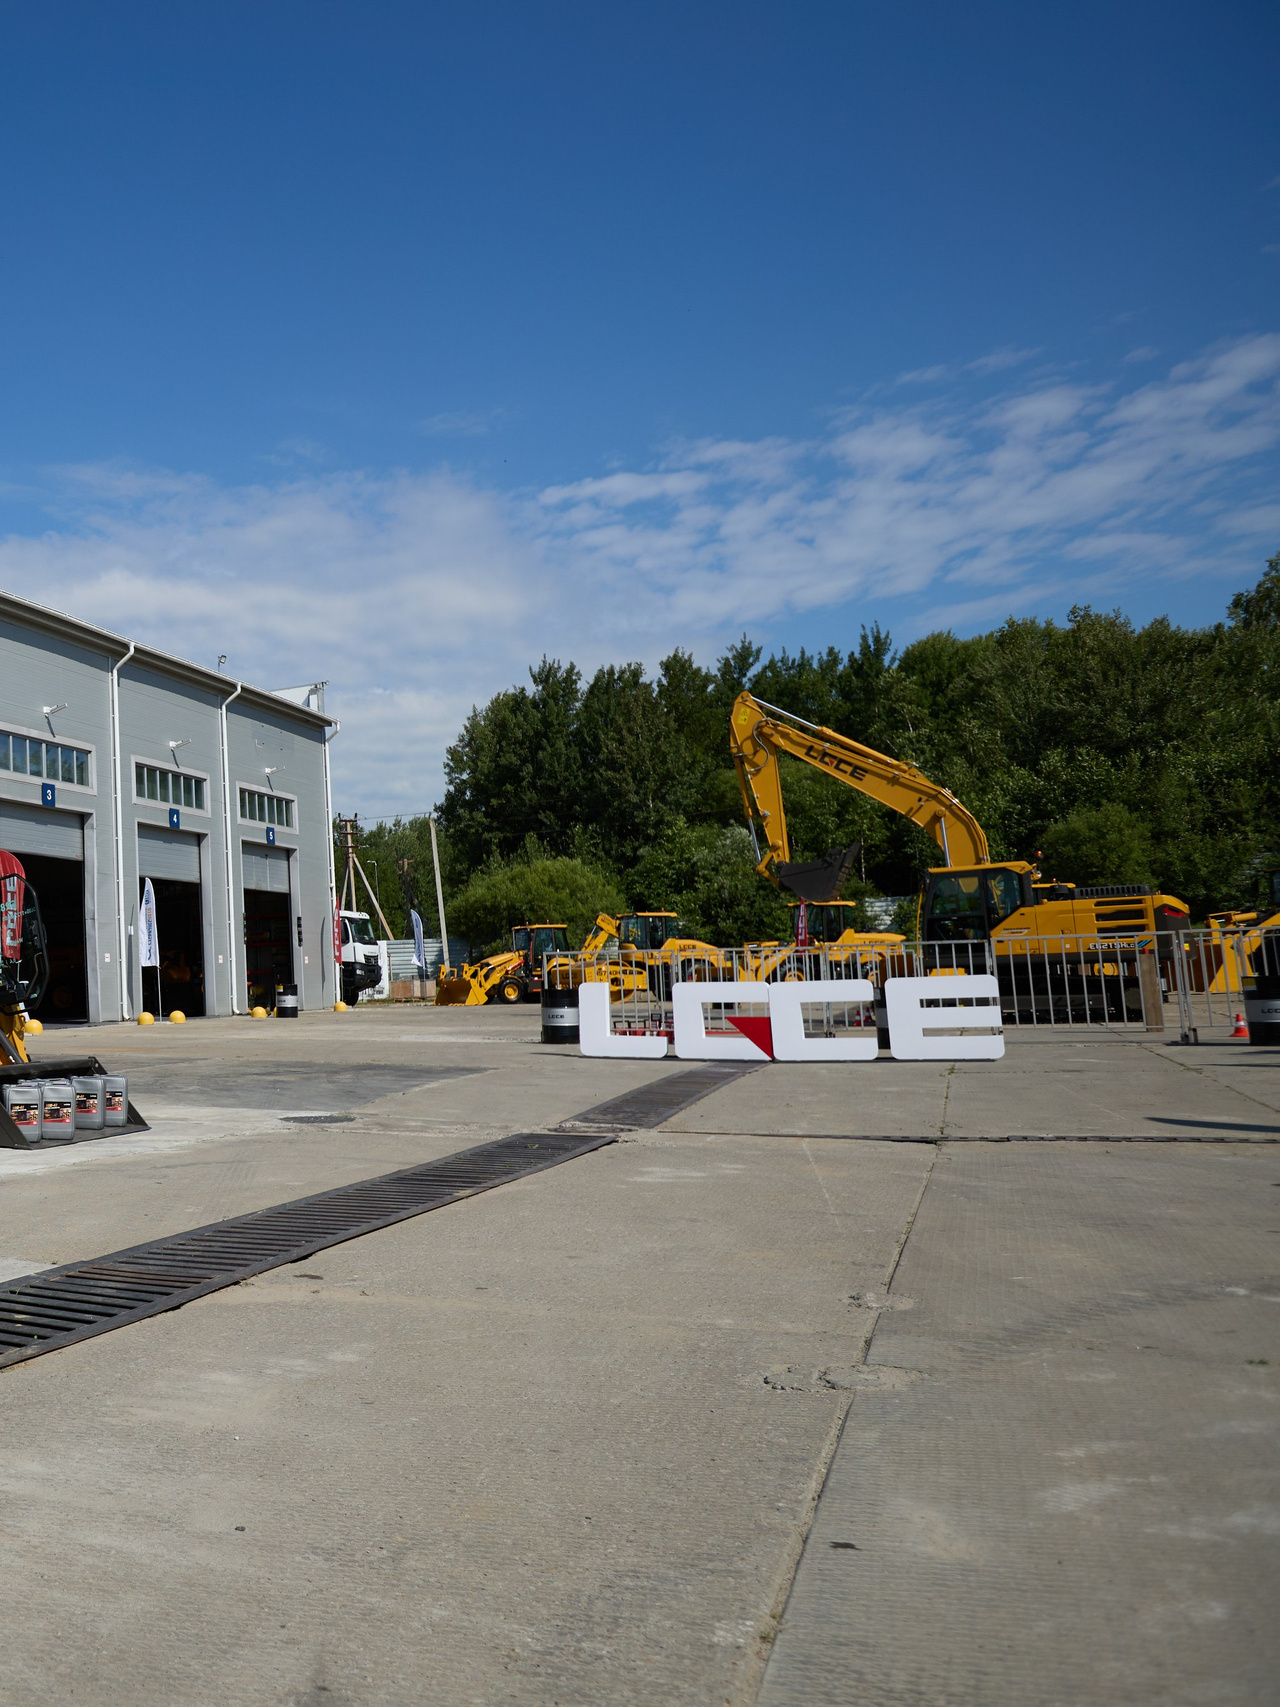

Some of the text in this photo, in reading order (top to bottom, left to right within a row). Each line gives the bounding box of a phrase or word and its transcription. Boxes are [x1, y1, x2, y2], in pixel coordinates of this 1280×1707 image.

[804, 744, 869, 782] LGCE
[46, 789, 52, 801] 3
[172, 813, 177, 823] 4
[269, 831, 273, 840] 5
[579, 974, 1006, 1061] LGCE
